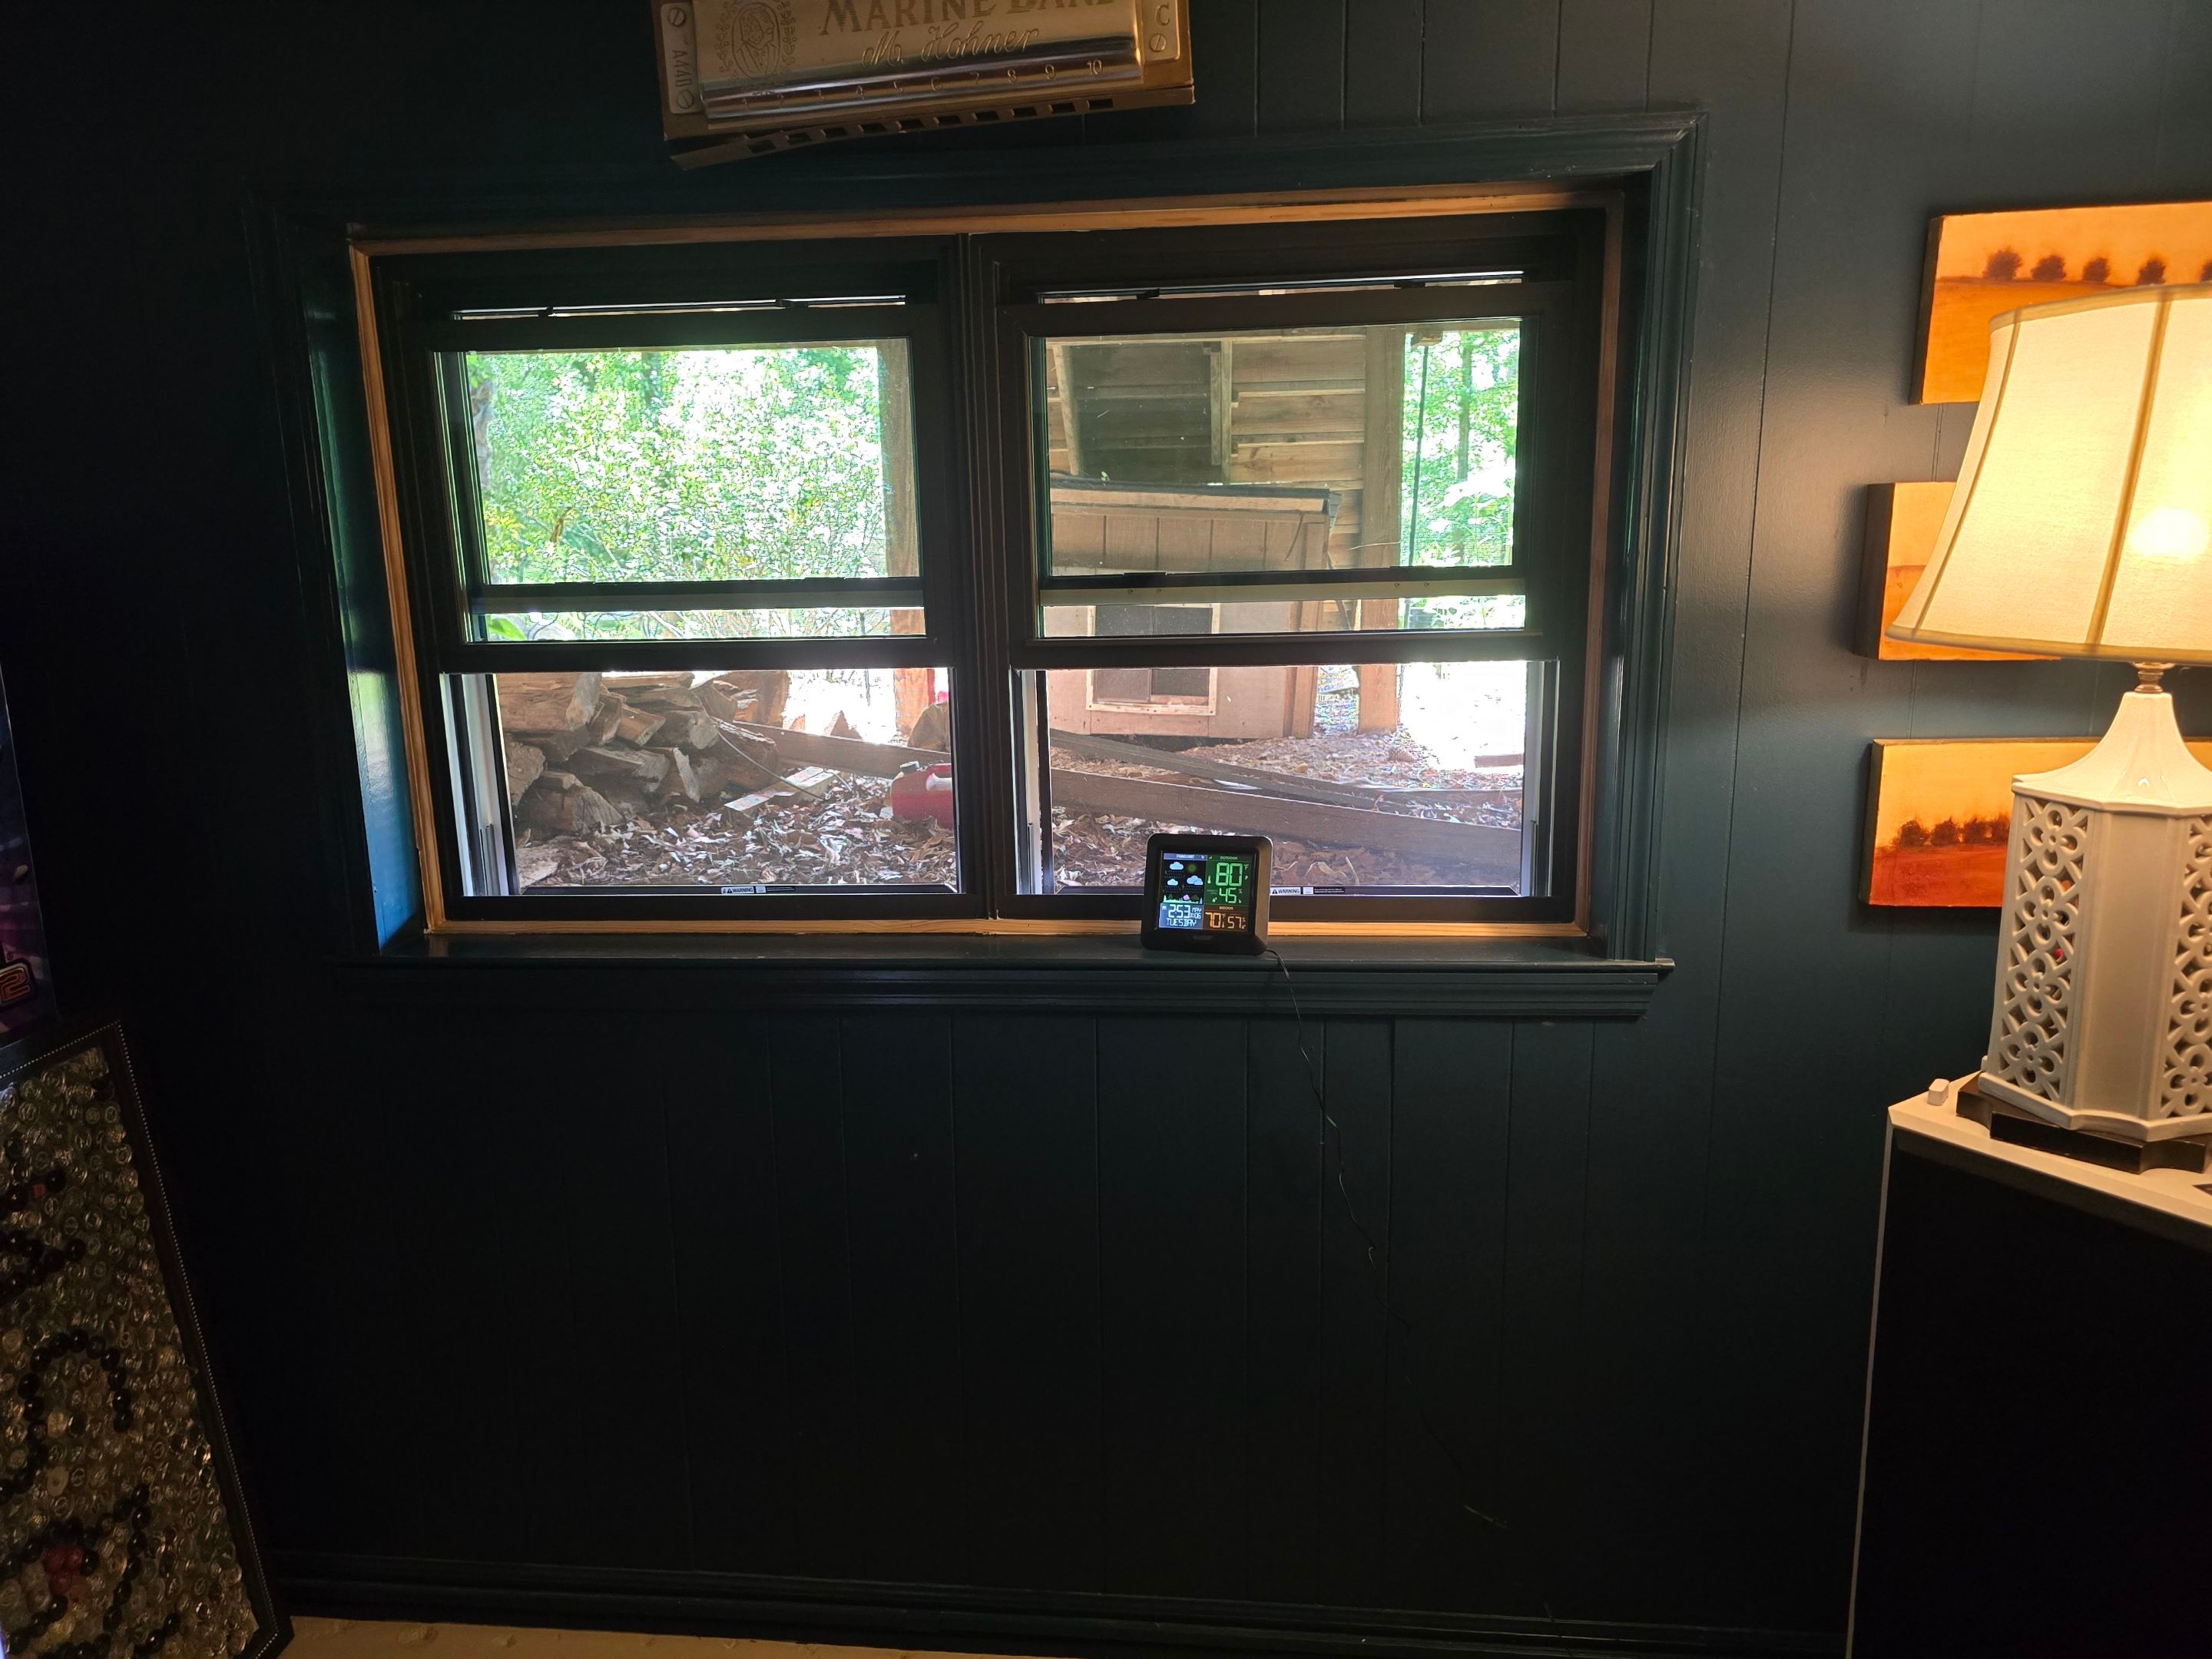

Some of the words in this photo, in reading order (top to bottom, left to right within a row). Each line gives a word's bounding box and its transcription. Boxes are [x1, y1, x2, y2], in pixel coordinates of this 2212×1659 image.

[1155, 2, 1171, 26] C
[921, 20, 1039, 62] Hohner
[1006, 67, 1018, 84] 8
[1045, 63, 1058, 80] 9
[1087, 59, 1104, 76] 10
[1216, 863, 1243, 886] 80
[1218, 887, 1237, 904] 45
[1166, 918, 1197, 927] TUESDAY
[1205, 912, 1221, 928] 70
[1227, 916, 1241, 929] 57
